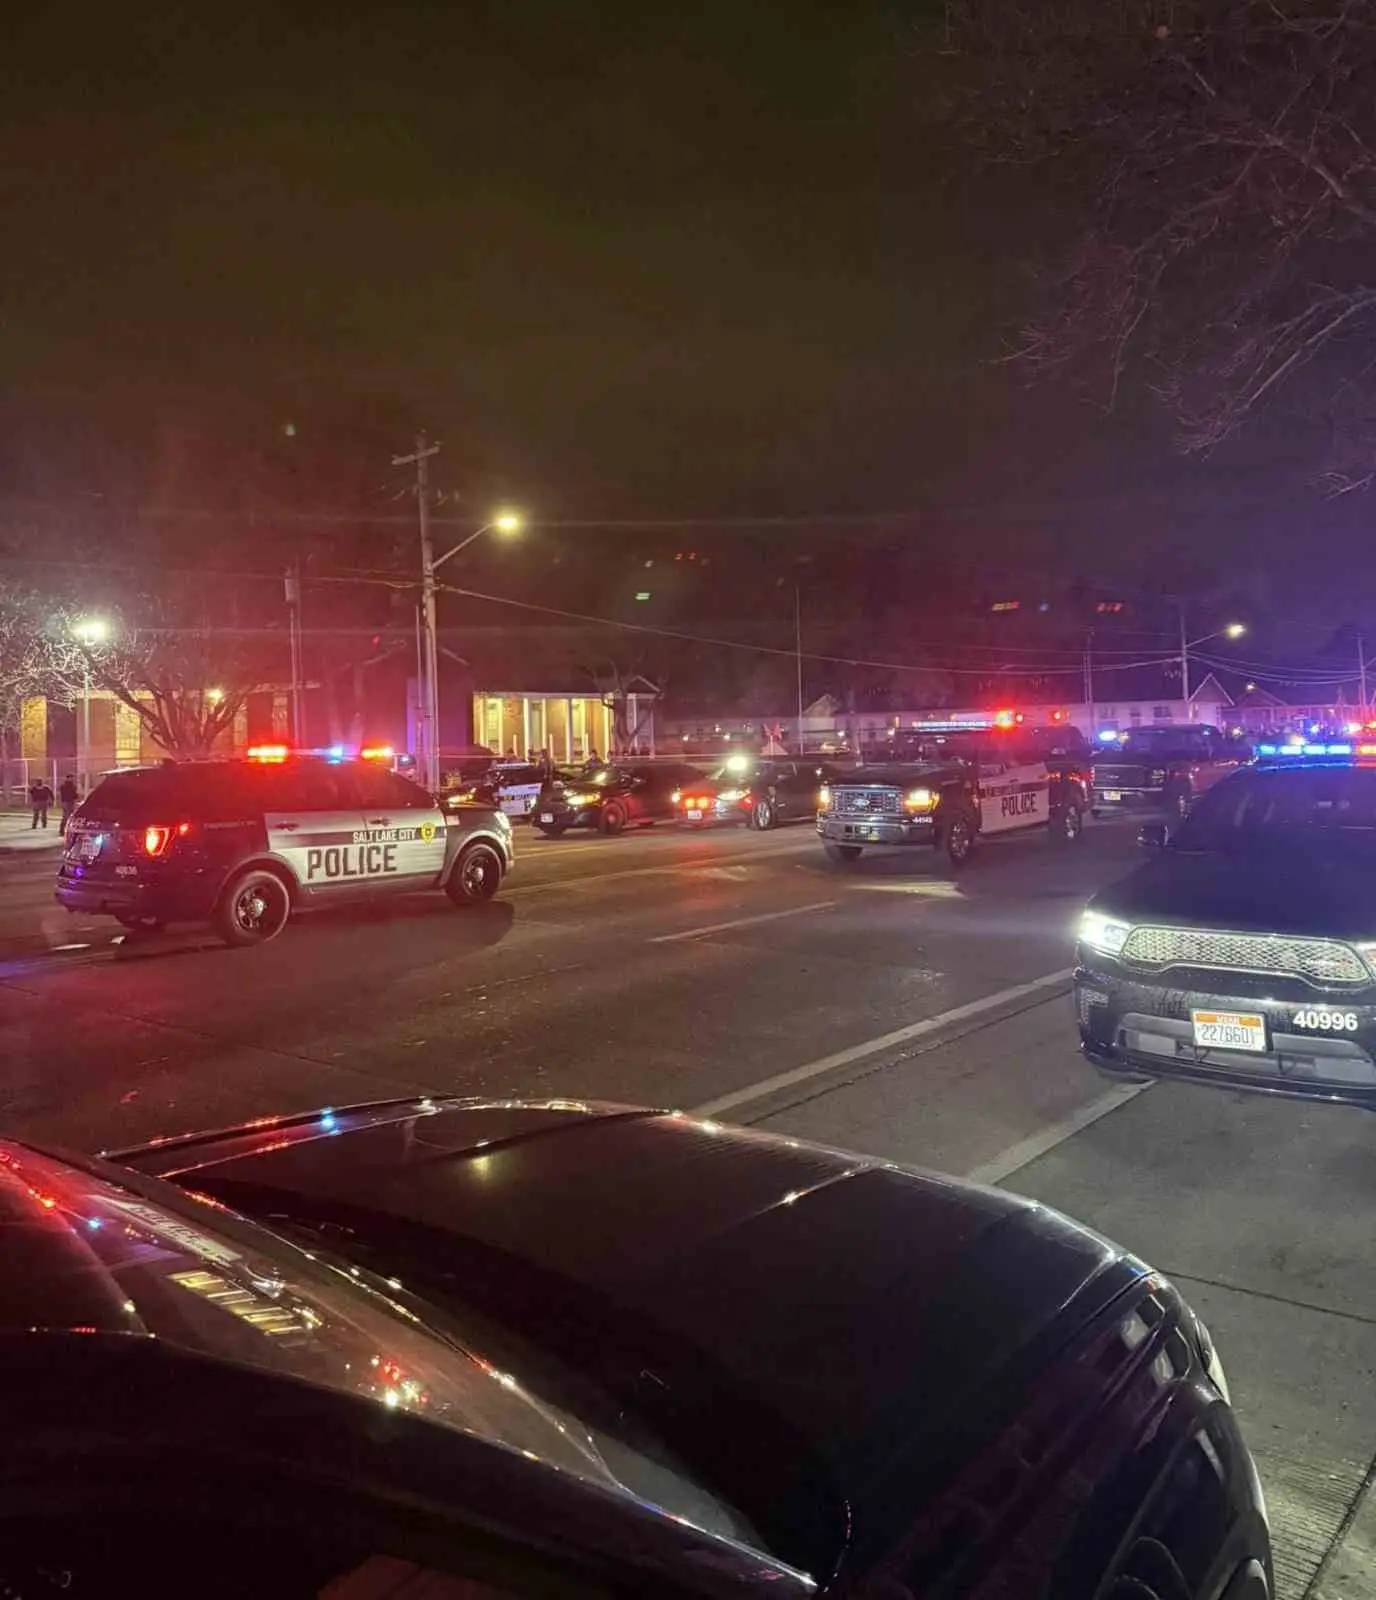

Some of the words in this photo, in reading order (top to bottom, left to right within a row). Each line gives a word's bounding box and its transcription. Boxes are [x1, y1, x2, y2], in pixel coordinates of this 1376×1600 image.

[1001, 792, 1038, 816] POLICE
[352, 830, 373, 842] SALT
[375, 829, 397, 841] LAKE
[399, 828, 416, 840] CITY
[307, 844, 398, 879] POLICE
[1293, 1010, 1359, 1031] 40996
